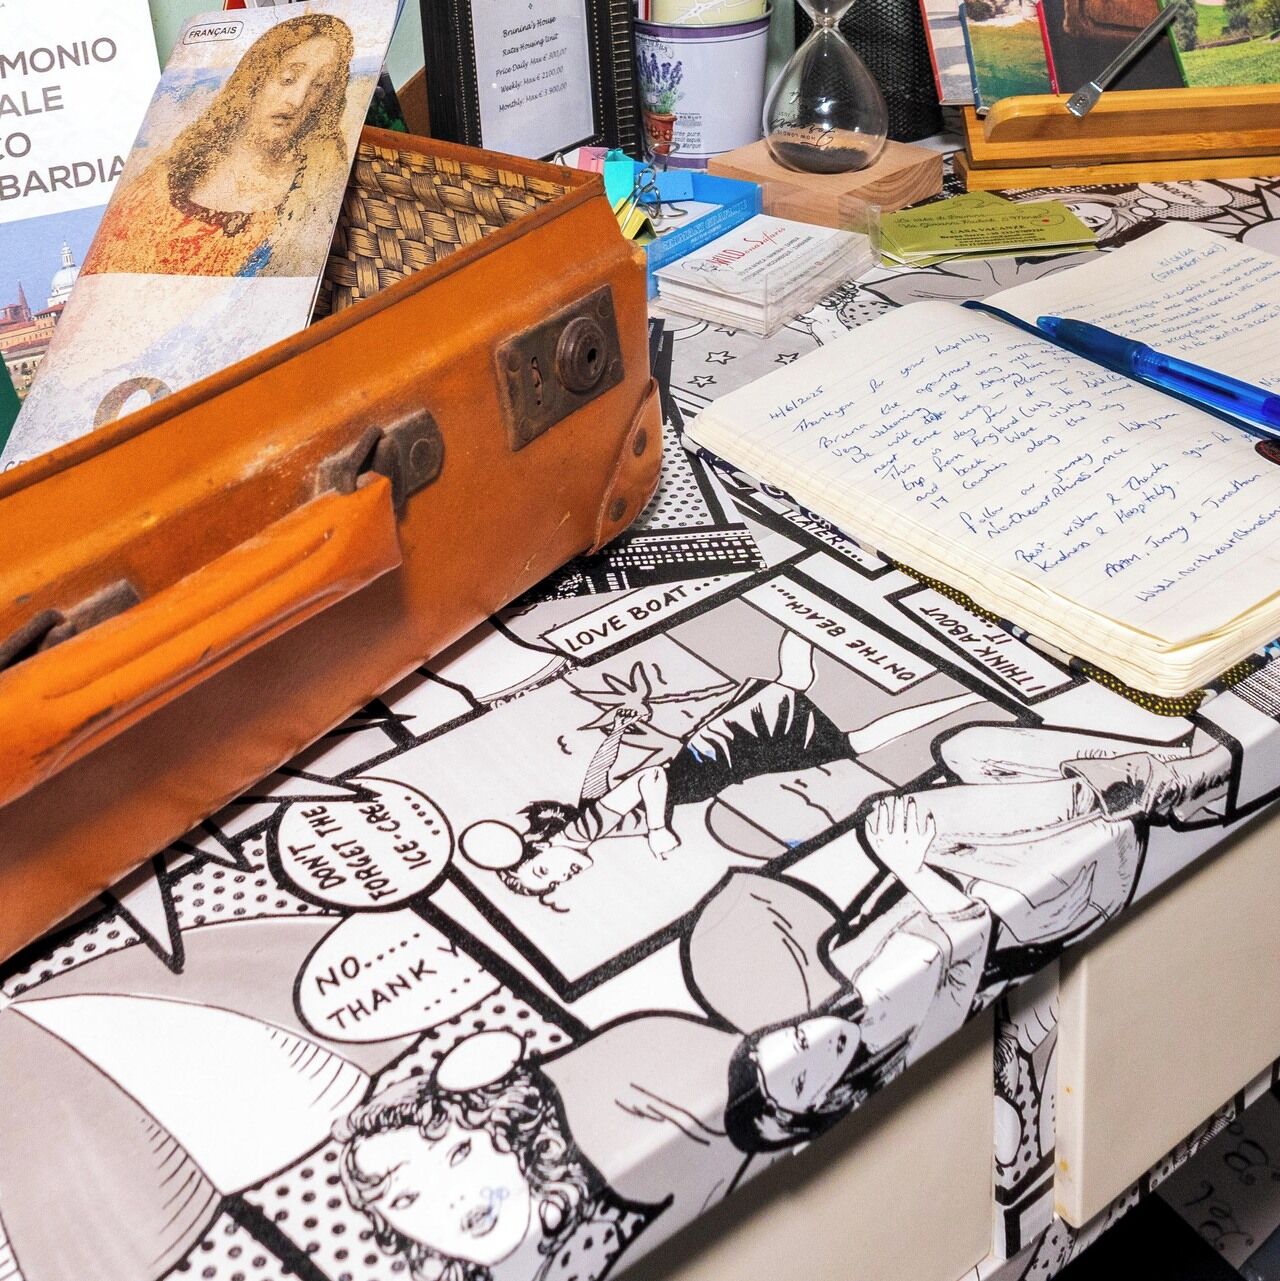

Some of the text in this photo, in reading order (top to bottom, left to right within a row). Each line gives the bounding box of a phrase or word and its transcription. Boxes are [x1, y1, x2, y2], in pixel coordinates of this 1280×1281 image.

[189, 27, 237, 39] FRANÇAIS
[566, 614, 626, 653] LOVE
[919, 606, 980, 642] ABOUT
[846, 639, 884, 664] THE
[974, 646, 1034, 685] THINK
[884, 662, 916, 681] ON
[287, 844, 347, 891] DON'T
[299, 805, 399, 904] FORGET THE
[325, 958, 438, 1031] THANK
